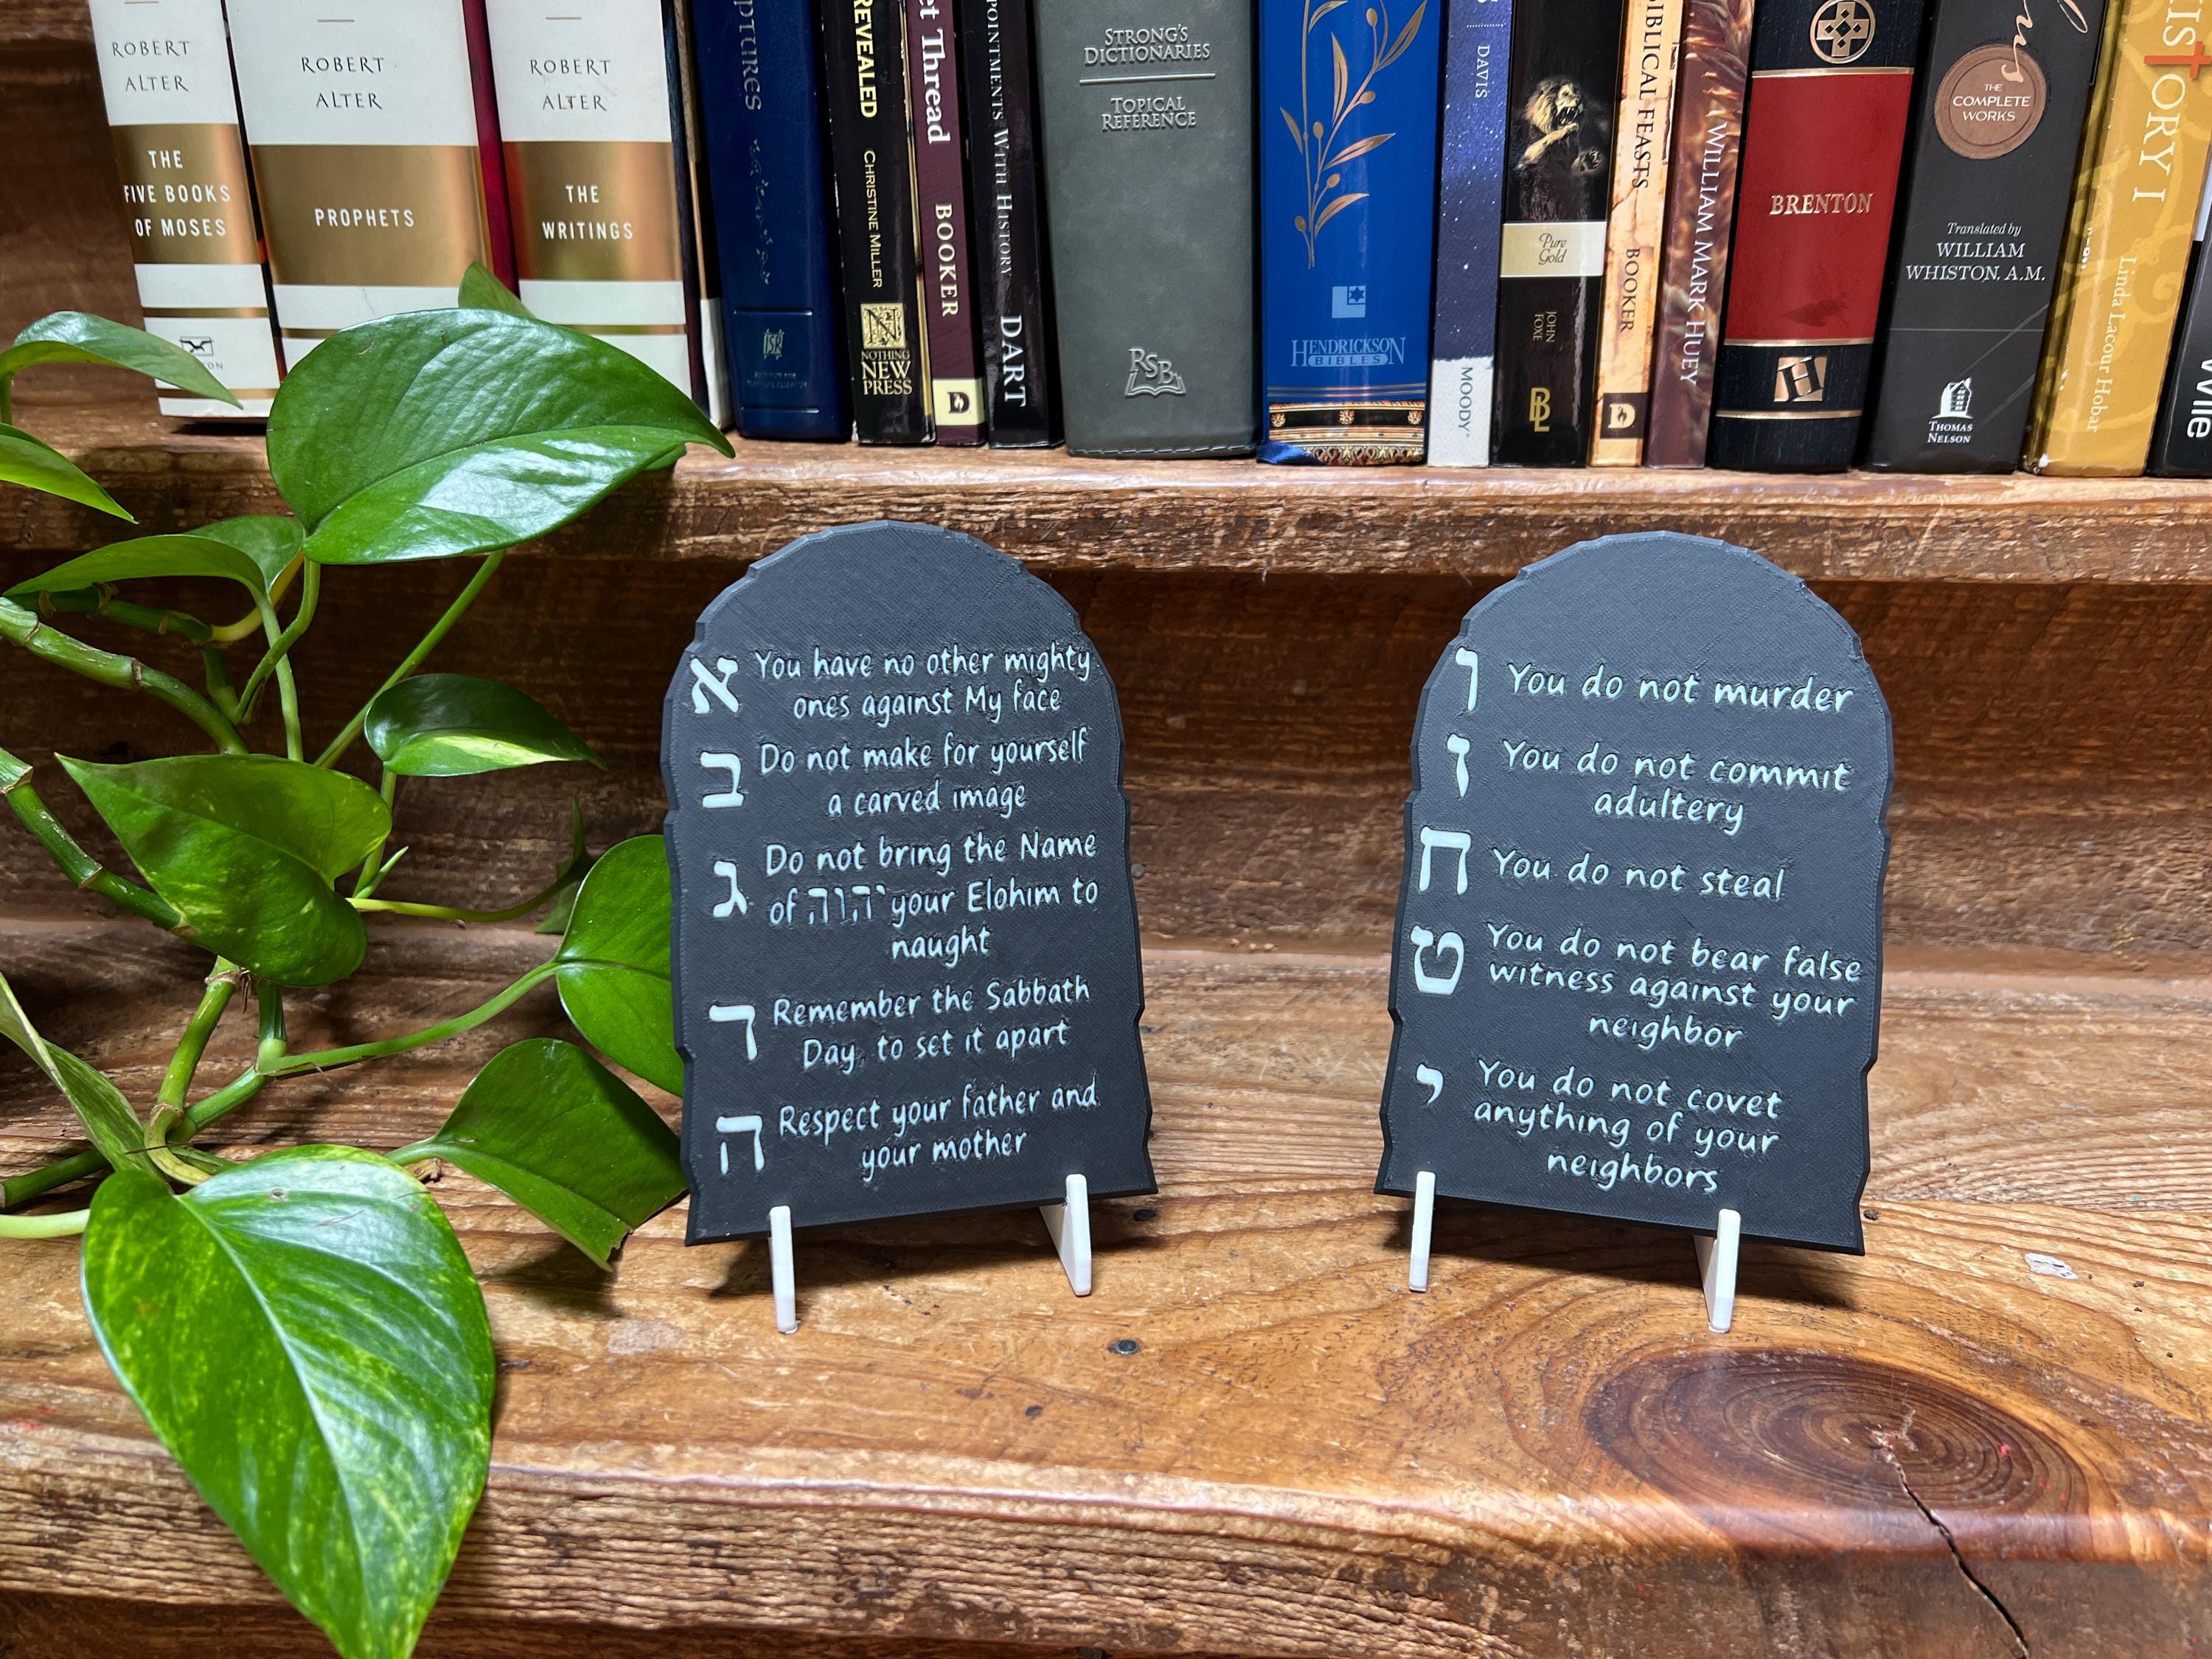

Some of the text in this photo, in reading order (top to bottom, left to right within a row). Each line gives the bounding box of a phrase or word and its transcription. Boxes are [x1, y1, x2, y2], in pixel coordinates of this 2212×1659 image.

[112, 41, 189, 58] ROBERT
[1084, 44, 1210, 65] DICTIONARIES
[1105, 24, 1188, 46] STRONG'S
[125, 75, 188, 92] ALTER
[302, 57, 384, 74] ROBERT
[529, 59, 611, 75] ROBERT
[1475, 45, 1490, 98] DAVIS
[316, 92, 382, 110] ALTER
[543, 94, 608, 111] ALTER
[922, 29, 951, 145] Thread
[1110, 97, 1186, 114] TOPICAL
[1632, 0, 1664, 189] IBLICAL FEASTS
[1953, 96, 2031, 107] COMPLETE
[1984, 83, 2003, 91] THE
[1102, 112, 1197, 131] REFERENCE
[1963, 111, 2015, 122] WORKS
[147, 150, 183, 168] THE
[123, 184, 231, 203] FIVE BOOKS
[566, 185, 599, 204] THE
[1770, 192, 1873, 216] BRENTON
[2132, 187, 2166, 202] I
[135, 218, 226, 237] OF MOSES
[314, 208, 415, 227] PROPHETS
[542, 221, 633, 240] WRITINGS
[863, 150, 883, 288] CHRISTINE MILLER
[1947, 222, 2022, 237] Translated by
[935, 204, 959, 317] BOOKER
[1539, 233, 1567, 248] Pure
[1539, 248, 1567, 265] Gold
[1680, 122, 1728, 386] WILLIAM MARK HUEY
[1936, 242, 2025, 258] WILLIAM
[1620, 248, 1641, 333] BOOKER
[2004, 265, 2045, 281] A.M.
[1533, 314, 1544, 341] FOXE
[1546, 311, 1557, 342] JOHN
[2087, 257, 2137, 433] Linda Lacour Hobar
[860, 361, 911, 380] NEW
[861, 350, 910, 361] NOTHING
[1001, 315, 1026, 406] DART
[1128, 348, 1175, 383] RSB
[1290, 337, 1406, 366] HENDRICKSON
[1315, 355, 1381, 366] BIBLES
[863, 380, 913, 395] PRESS
[1458, 366, 1473, 432] MOODY
[1927, 433, 1971, 443] NELSON
[1928, 420, 1973, 432] THOMAS
[754, 641, 1090, 684] You have no other mighty
[1455, 647, 1478, 713] ו
[689, 657, 739, 714] א
[793, 678, 1060, 728] ones against My face
[1508, 664, 1854, 714] You do not murder
[761, 726, 1087, 776] Do not make for yourself
[1447, 734, 1470, 799] ז
[1503, 740, 1851, 792] You do not commit
[699, 751, 744, 809] ב
[828, 779, 1026, 819] a carved image
[1594, 785, 1744, 836] adultery
[766, 831, 1096, 877] Do not bring the Name
[1418, 826, 1472, 896] ח
[712, 860, 748, 918] ג
[1493, 849, 1784, 902] You do not steal
[770, 887, 798, 925] of
[891, 891, 955, 928] your
[967, 877, 1060, 913] Elohim
[1072, 877, 1098, 905] to
[891, 925, 990, 968] naught
[1410, 925, 1464, 995] ט
[1487, 923, 1860, 983] You do not bear false
[773, 974, 1090, 1026] Remember the Sabbath
[1489, 962, 1855, 1021] witness against your
[709, 1004, 758, 1061] ד
[877, 1035, 903, 1061] to
[917, 1029, 953, 1058] set
[965, 1027, 983, 1052] it
[995, 1019, 1068, 1058] apart
[1589, 1014, 1743, 1051] neighbor
[1416, 1063, 1444, 1104] י
[1478, 1059, 1783, 1119] You do not covet
[779, 1077, 1097, 1146] Respect your father and
[1474, 1102, 1779, 1158] anything of your
[715, 1115, 765, 1175] ה
[862, 1129, 1027, 1183] your mother
[1548, 1152, 1718, 1193] neighbors
